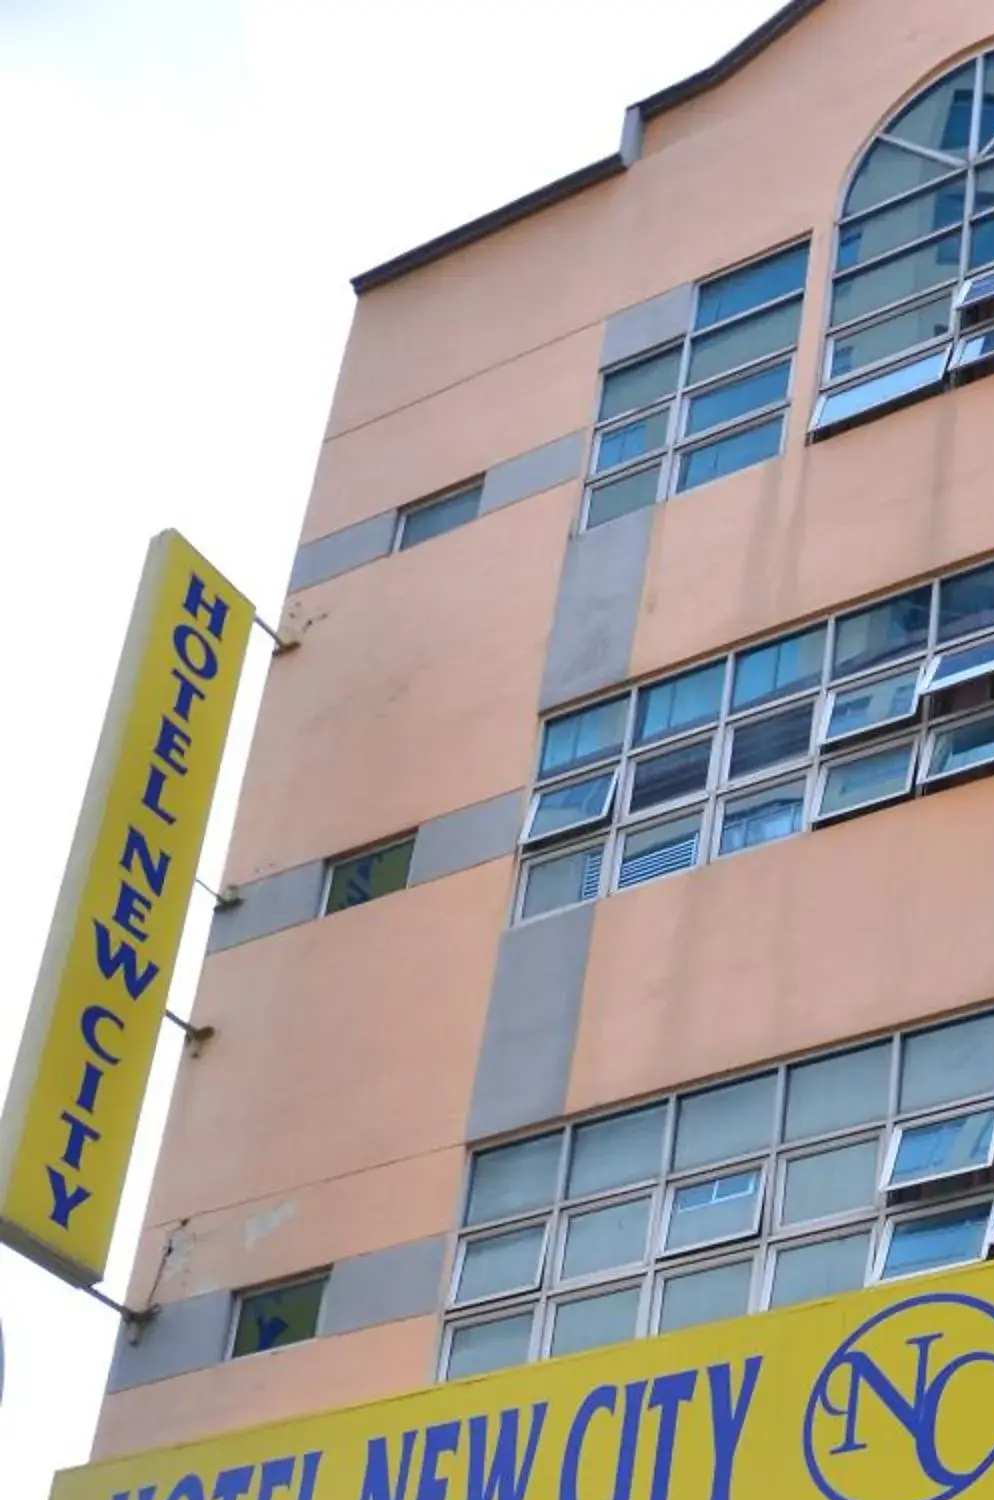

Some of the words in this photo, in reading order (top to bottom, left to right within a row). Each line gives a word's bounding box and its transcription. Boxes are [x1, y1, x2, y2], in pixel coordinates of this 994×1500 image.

[140, 570, 230, 826] HOTEL
[93, 825, 172, 1001] NEW
[45, 1004, 126, 1232] CITY
